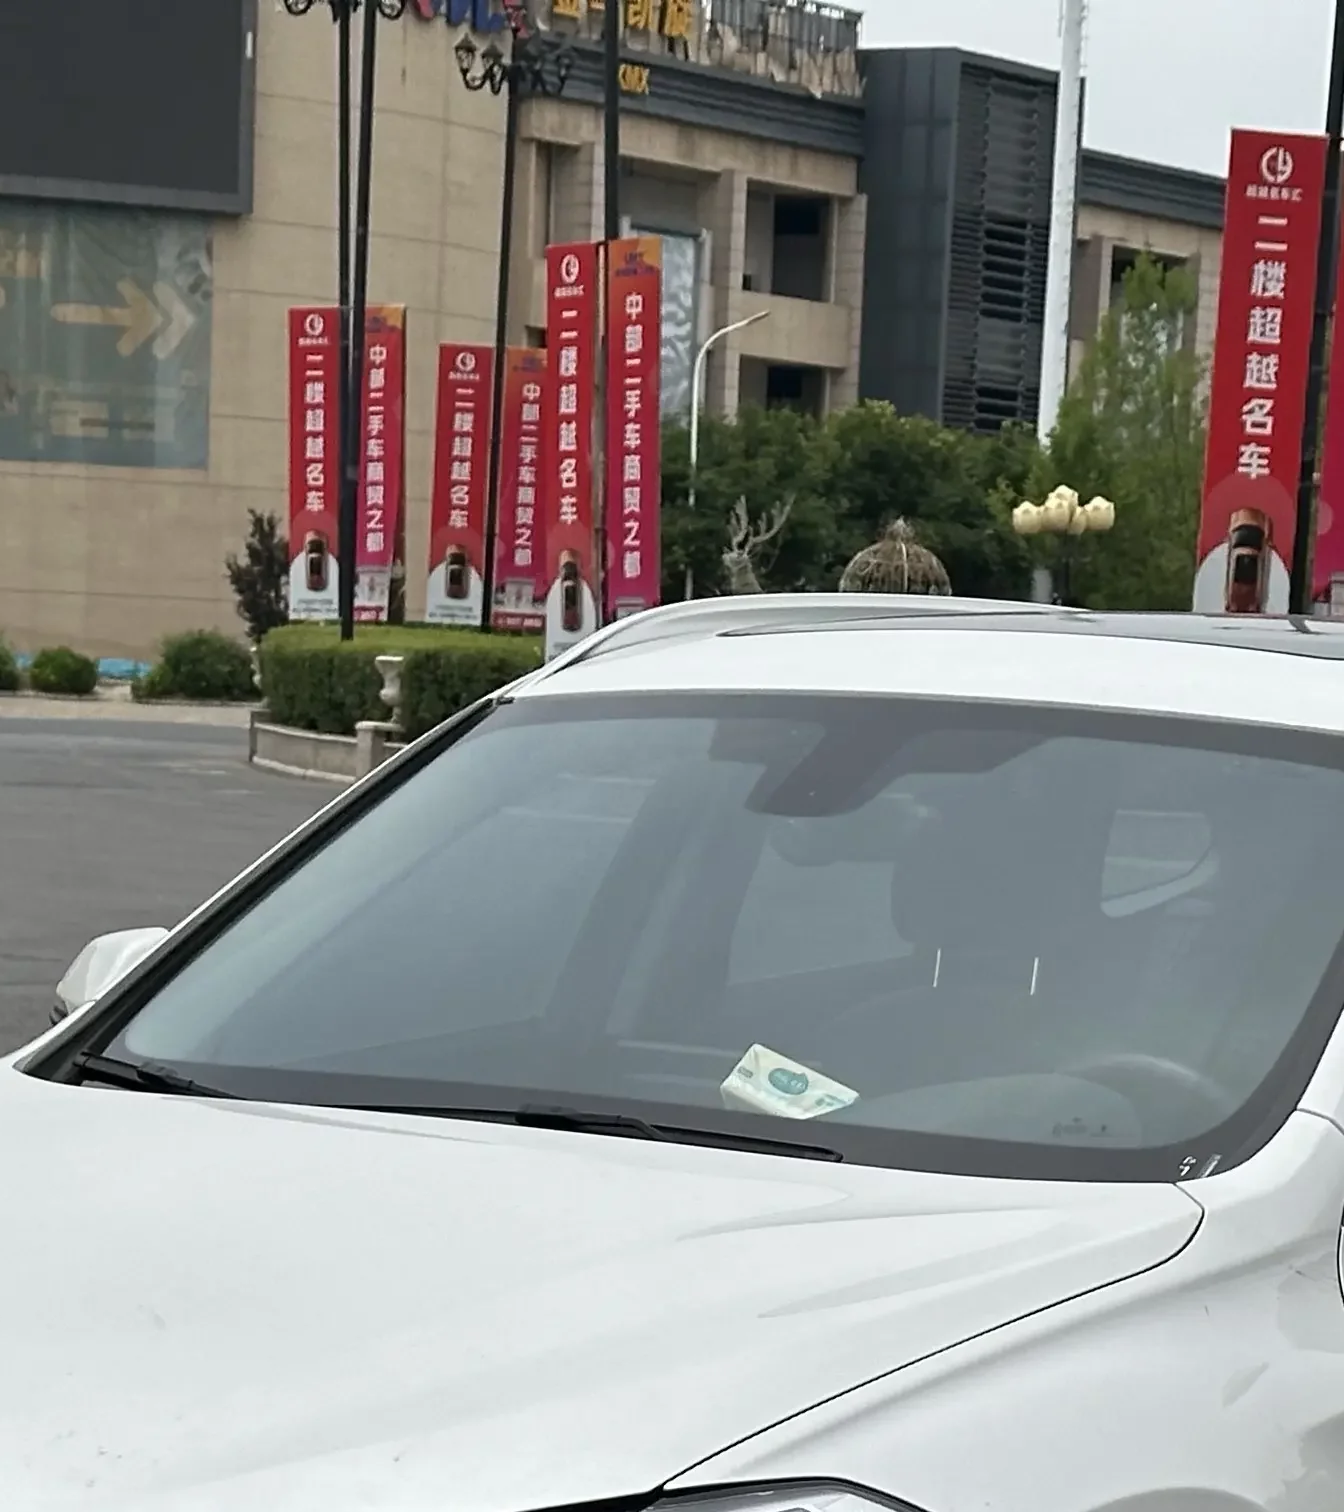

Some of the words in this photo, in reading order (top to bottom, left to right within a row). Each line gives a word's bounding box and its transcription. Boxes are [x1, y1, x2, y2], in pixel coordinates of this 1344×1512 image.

[305, 354, 325, 512] 二楼超越名车
[559, 309, 579, 524] 二楼超越名车
[623, 292, 644, 579] 中部二手车商贸之都
[1237, 213, 1289, 479] 二楼超越名车
[448, 388, 475, 528] 二楼超越名车
